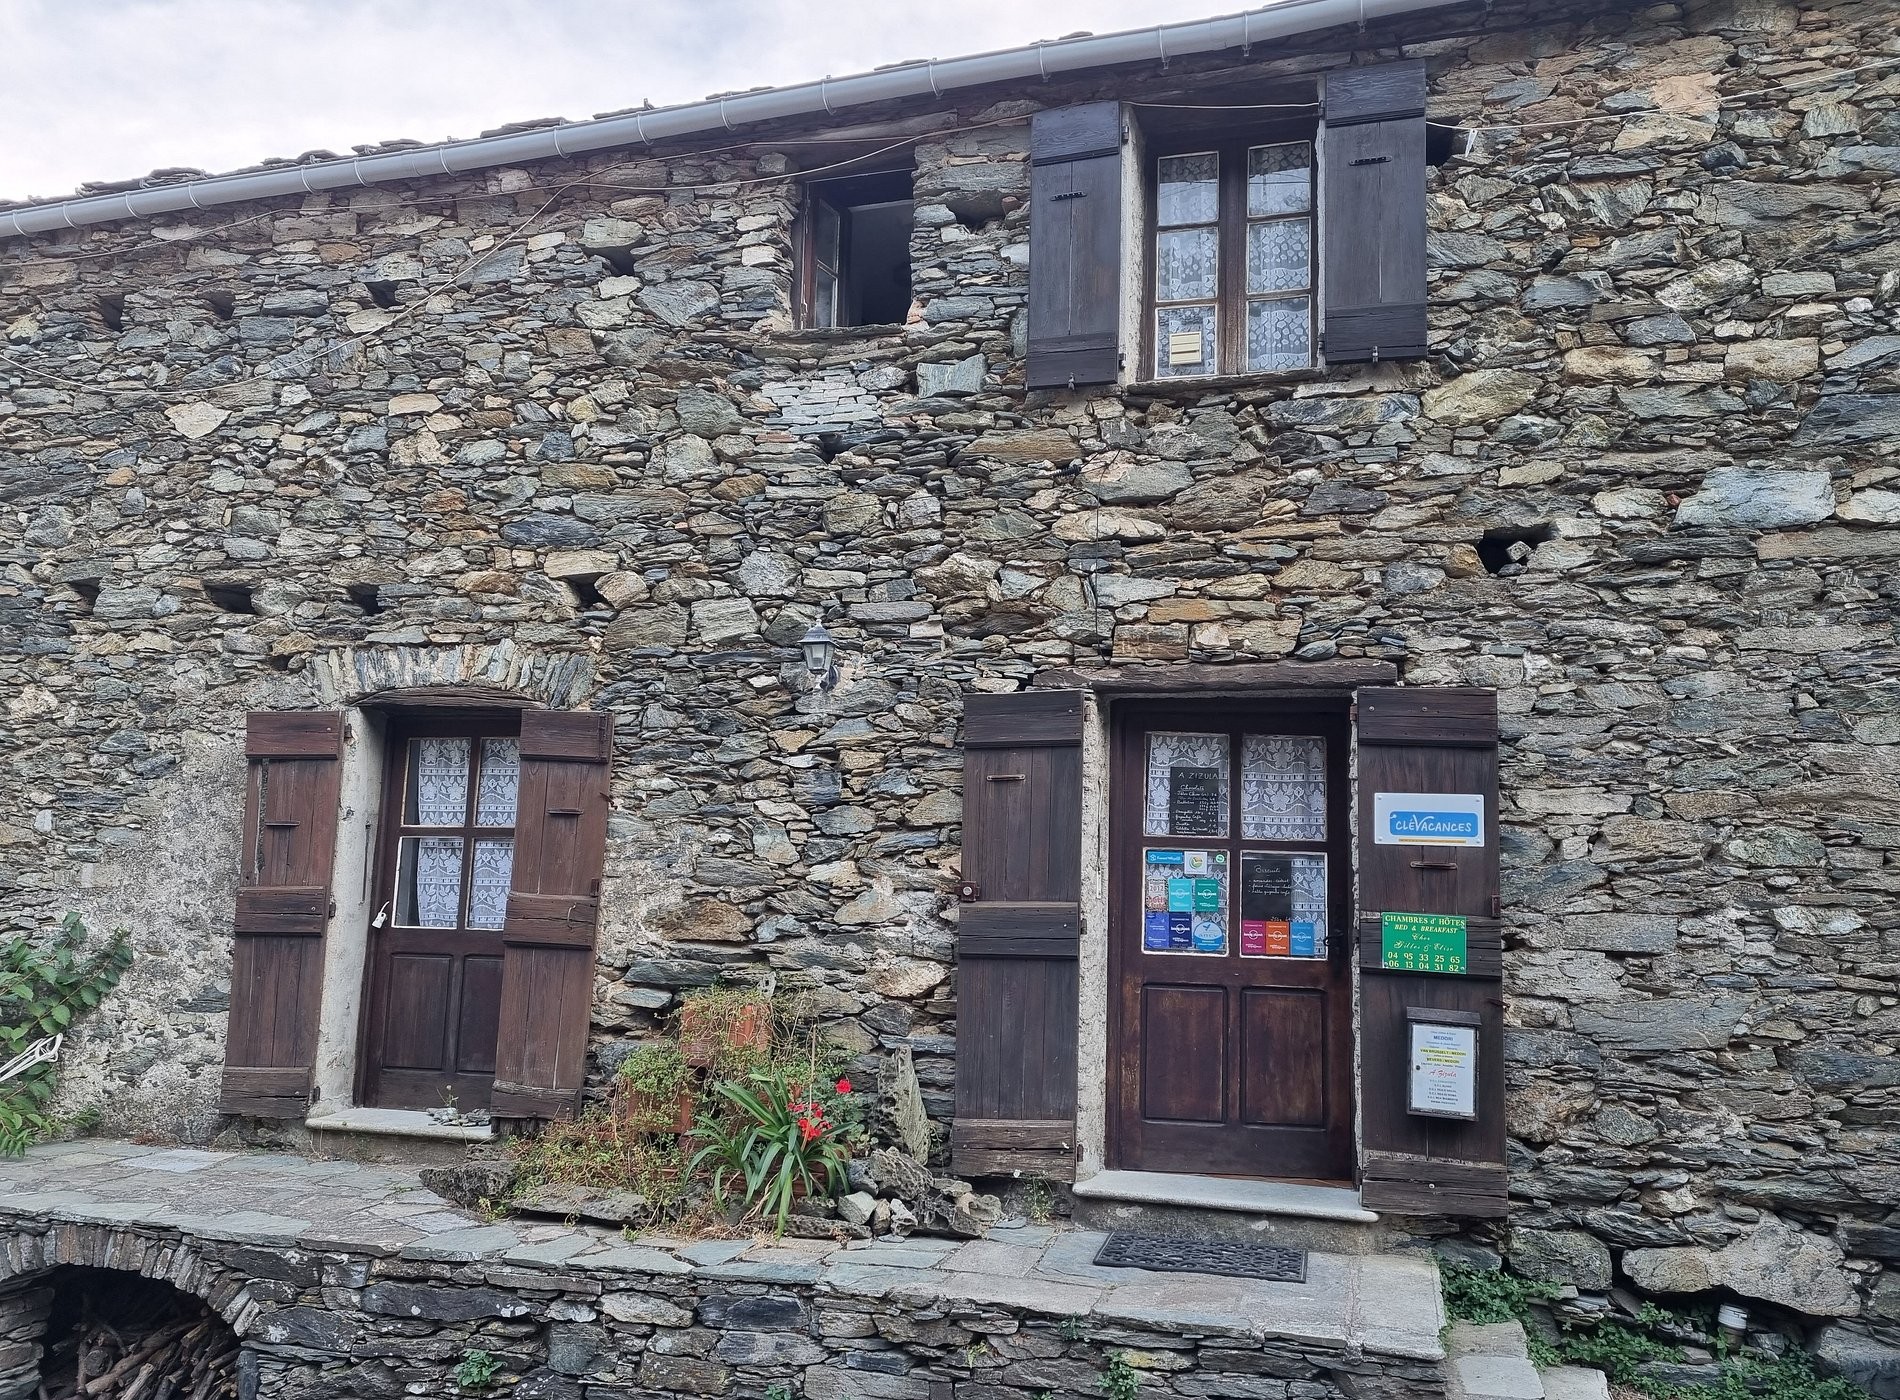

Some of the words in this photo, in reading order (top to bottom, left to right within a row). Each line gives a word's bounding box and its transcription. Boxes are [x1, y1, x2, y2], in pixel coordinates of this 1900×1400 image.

[1385, 914, 1428, 925] CHAMBRES
[1439, 916, 1465, 927] HÔTES
[1421, 926, 1458, 934] BREAKFAST
[1388, 951, 1398, 959] 04
[1435, 955, 1445, 963] 25
[1450, 956, 1460, 964] 65
[1388, 960, 1399, 968] 06
[1405, 961, 1413, 969] 13
[1419, 962, 1429, 970] 04
[1434, 963, 1443, 971] 31
